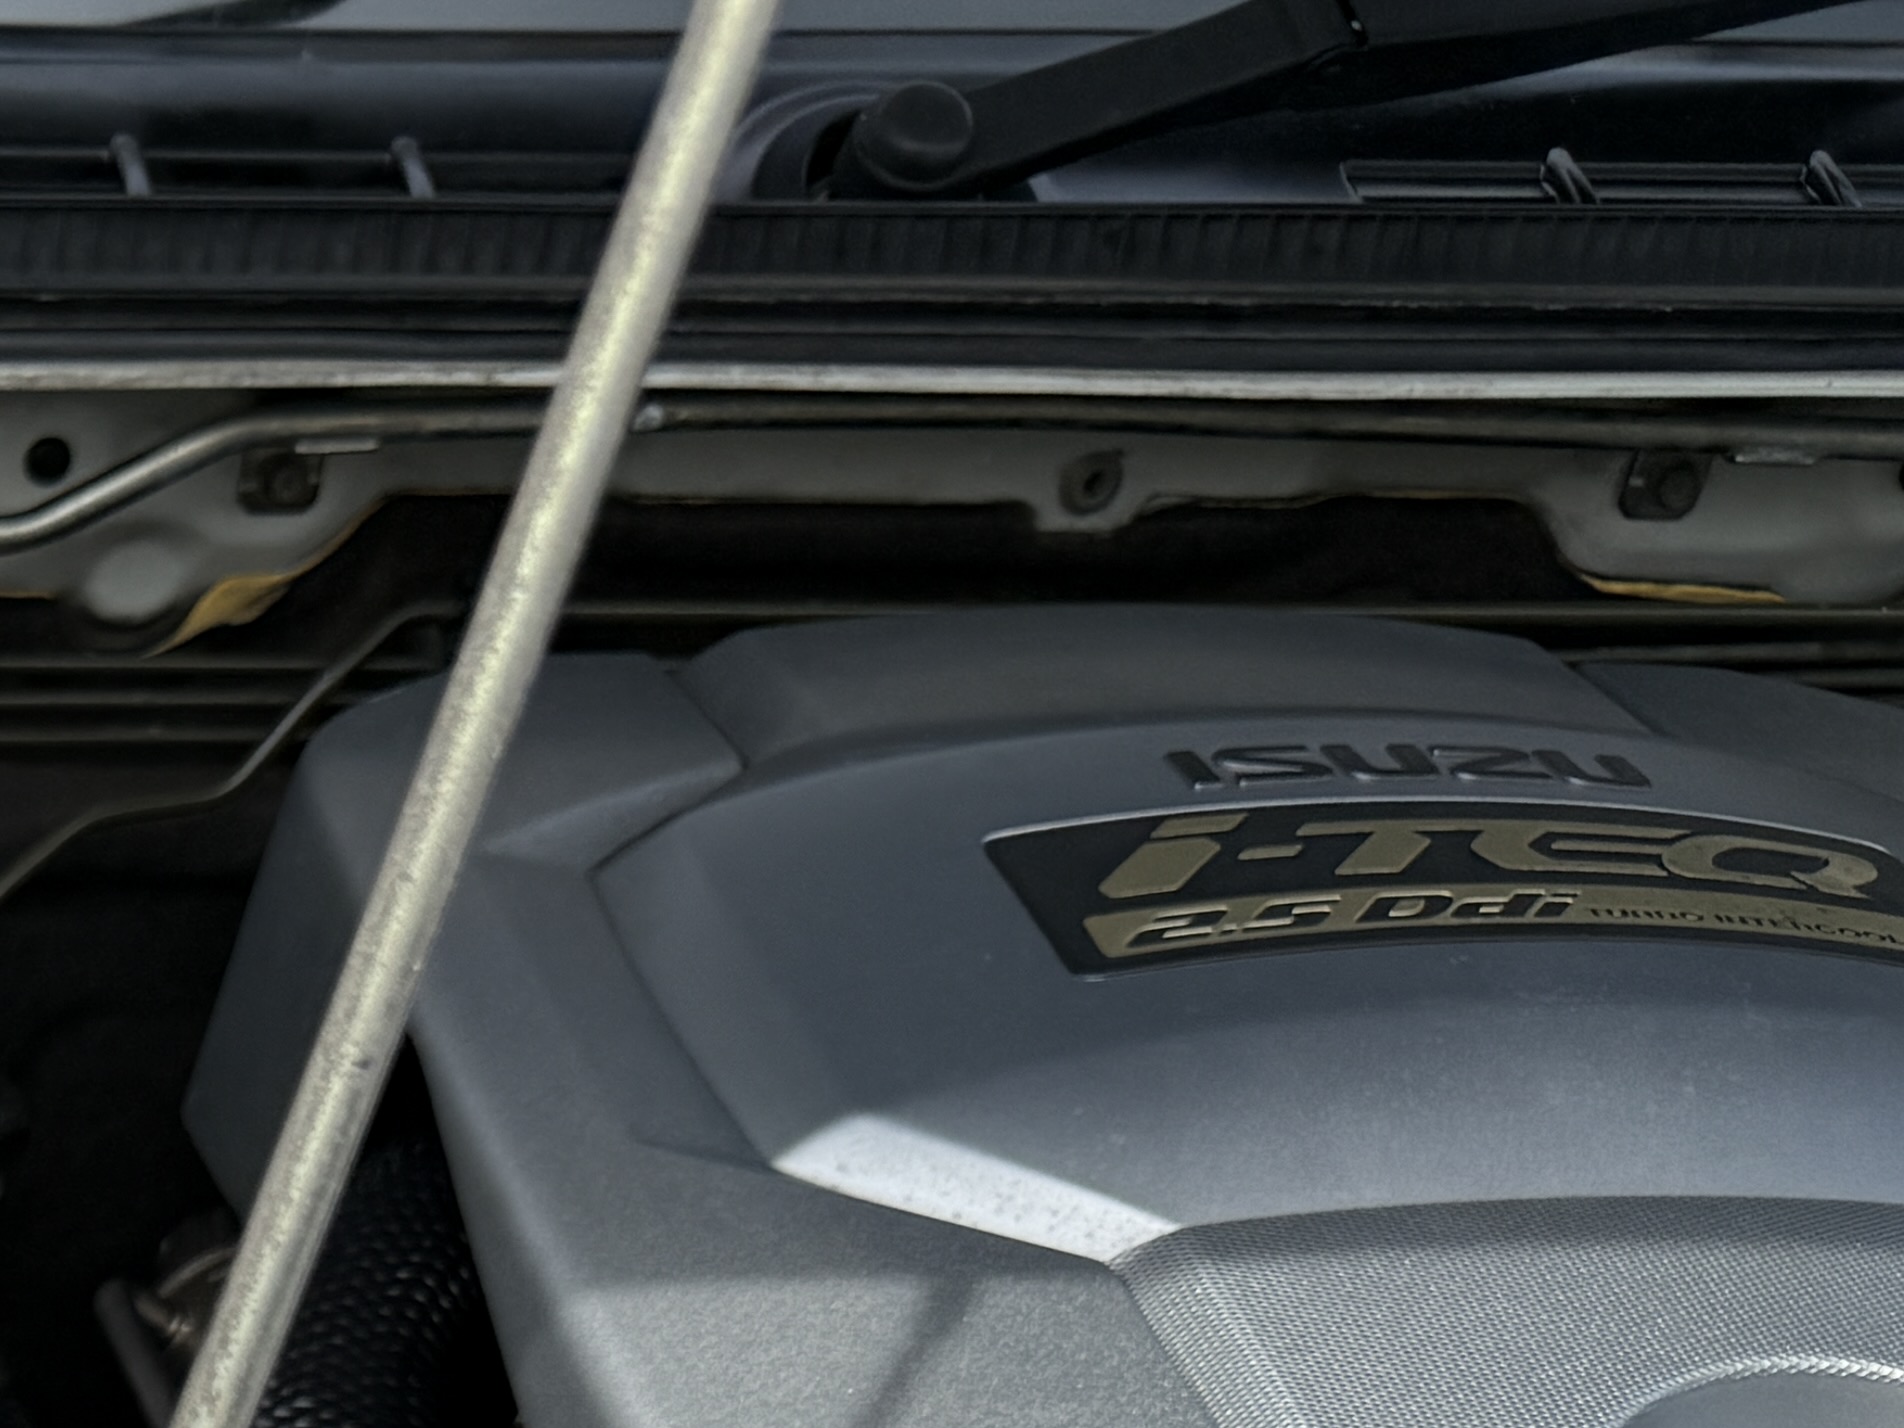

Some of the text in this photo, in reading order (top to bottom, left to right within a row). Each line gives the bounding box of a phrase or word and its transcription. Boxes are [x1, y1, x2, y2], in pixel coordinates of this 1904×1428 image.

[1164, 743, 1653, 790] ISUZU
[1098, 812, 1880, 899] i-TEQ
[1124, 894, 1341, 948] 2.5
[1355, 889, 1581, 924] Ddi
